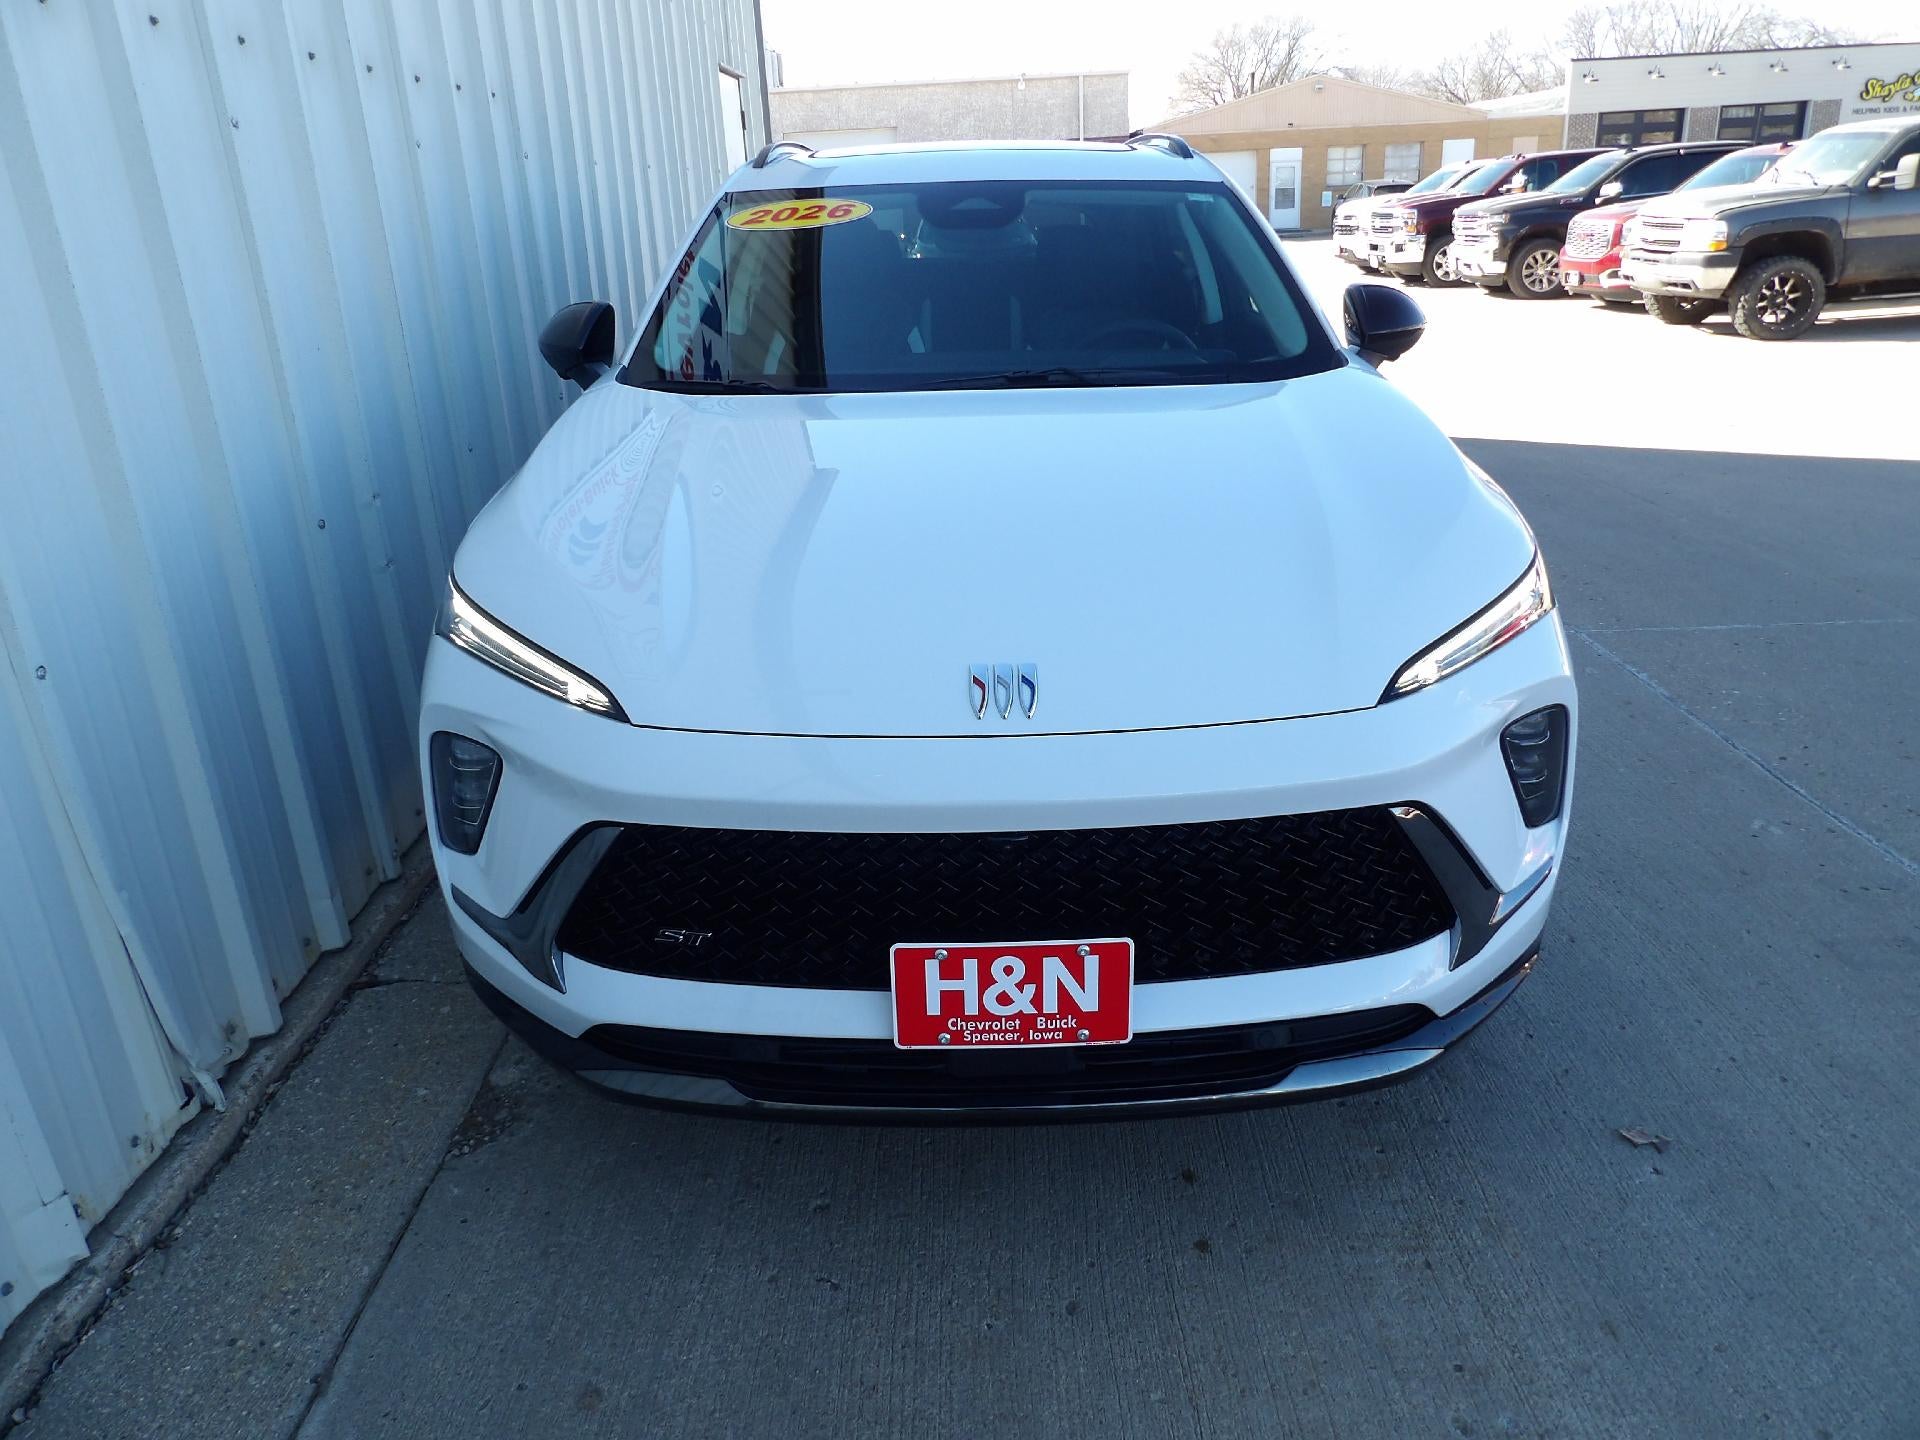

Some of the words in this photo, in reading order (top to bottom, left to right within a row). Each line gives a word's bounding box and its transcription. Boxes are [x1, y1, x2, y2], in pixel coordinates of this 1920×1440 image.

[740, 203, 857, 226] 2026
[654, 928, 713, 946] ST
[924, 955, 1100, 1016] H&N
[947, 1017, 1021, 1031] Chevrolet
[1036, 1014, 1077, 1029] Buick
[963, 1029, 1024, 1042] Spencer,
[1029, 1029, 1063, 1040] Iowa
